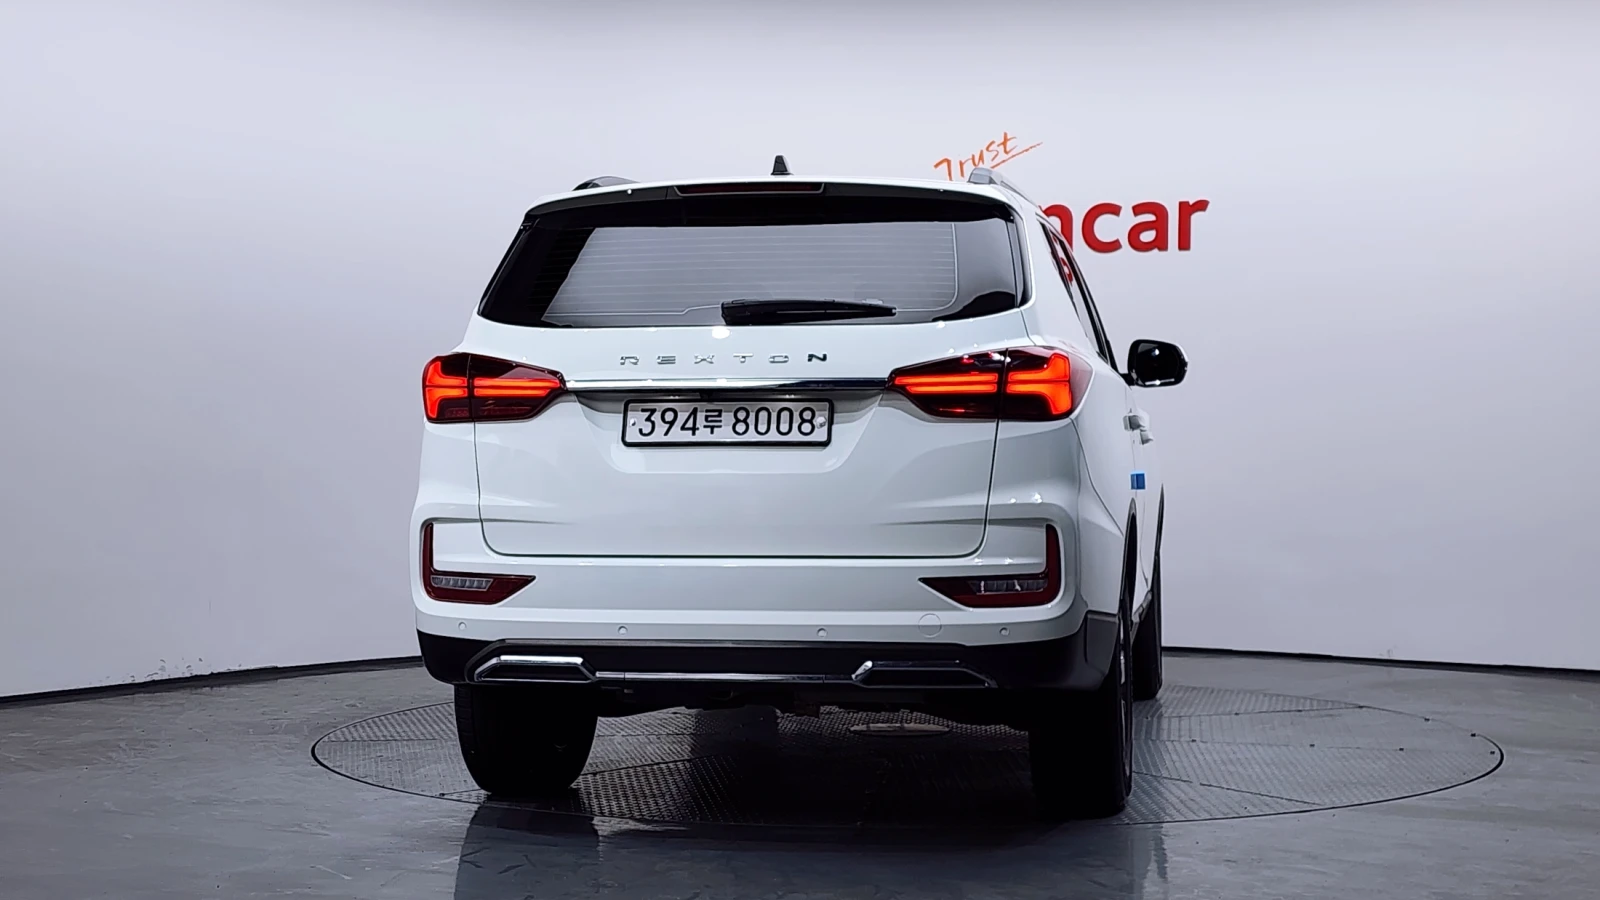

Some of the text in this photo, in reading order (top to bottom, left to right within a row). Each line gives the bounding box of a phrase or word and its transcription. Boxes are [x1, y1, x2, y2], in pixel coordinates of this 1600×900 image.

[933, 131, 1020, 181] Trust
[619, 352, 828, 366] REXTON
[638, 406, 816, 437] 394루 8008
